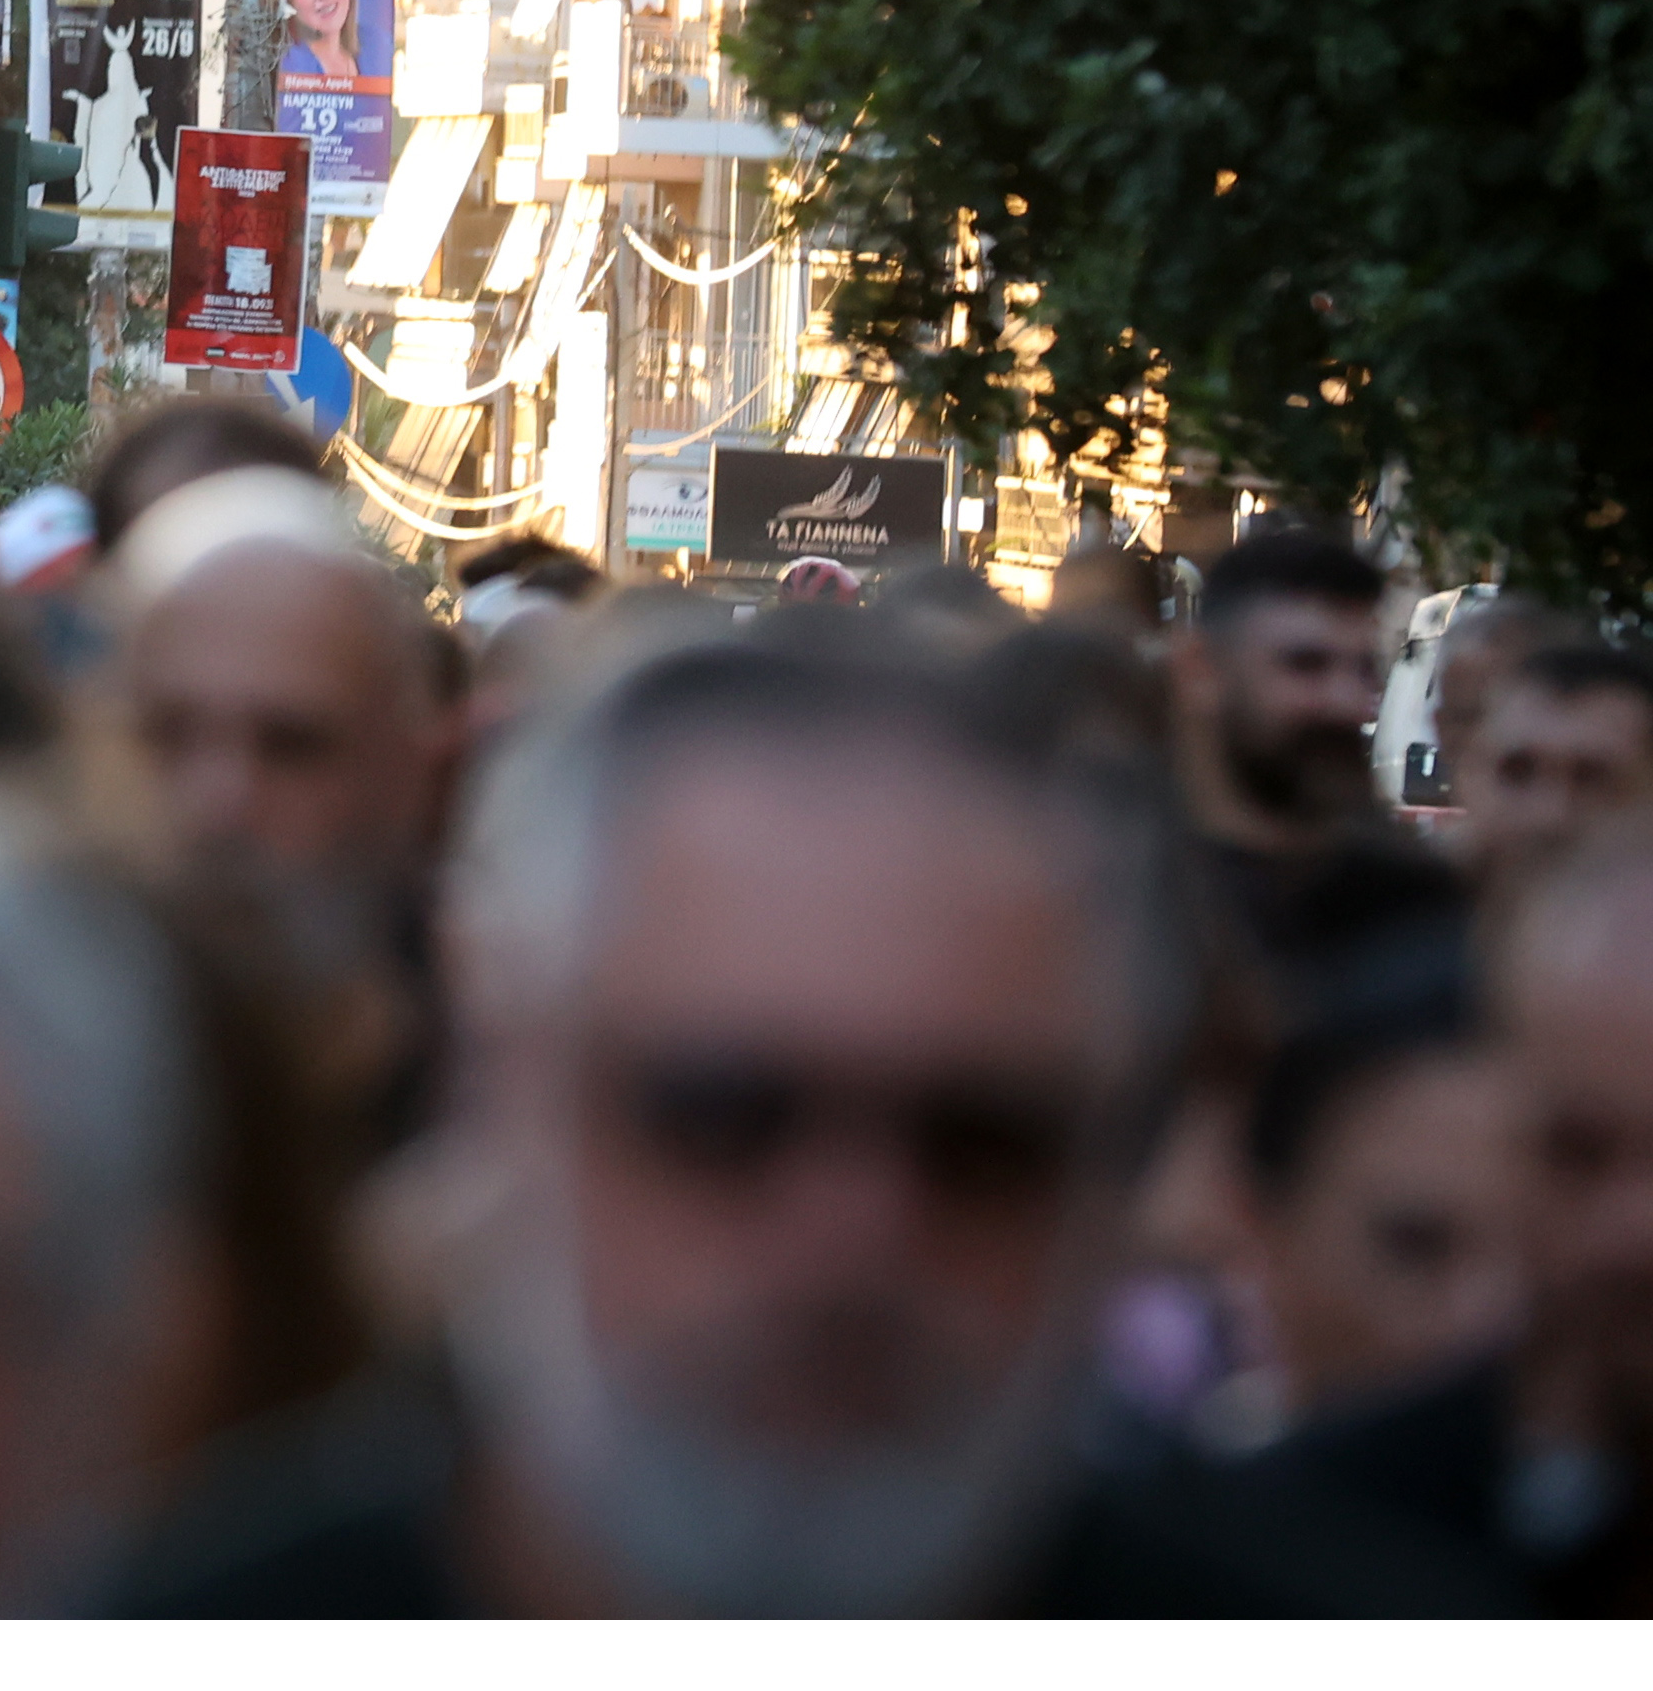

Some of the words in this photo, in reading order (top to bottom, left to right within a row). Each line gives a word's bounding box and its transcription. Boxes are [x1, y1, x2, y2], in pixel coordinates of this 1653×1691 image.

[283, 92, 354, 110] ΠΑΡΑΣΚΕΥΗ
[300, 108, 338, 137] 19
[766, 518, 790, 540] ΤΑ
[795, 520, 890, 545] ΓΙΑΝΝΕΝΑ
